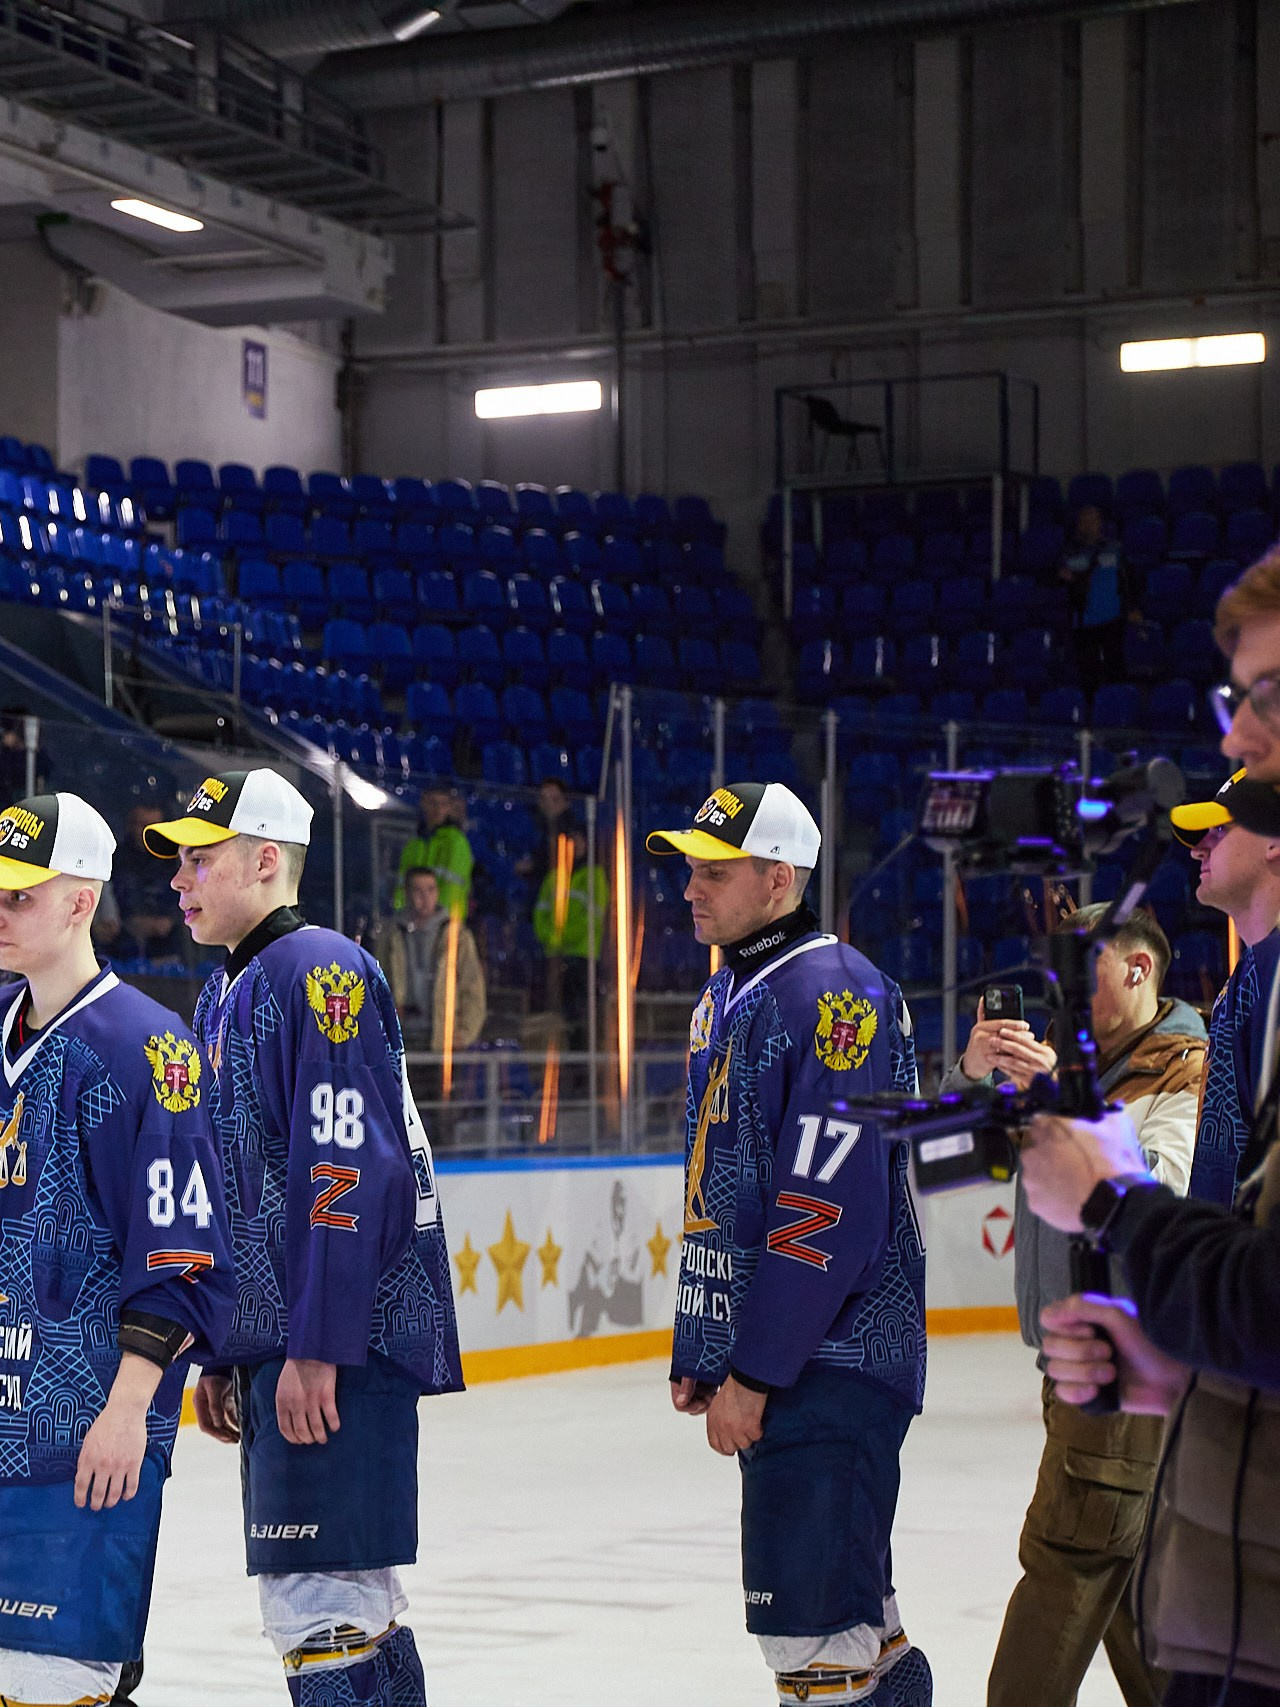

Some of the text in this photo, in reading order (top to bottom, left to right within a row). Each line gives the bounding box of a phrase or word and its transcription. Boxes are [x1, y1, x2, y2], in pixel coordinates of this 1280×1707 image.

[197, 796, 214, 812] 25
[709, 810, 727, 827] 25
[10, 832, 30, 850] 25
[739, 931, 787, 958] Reebok
[310, 1082, 365, 1150] 98
[791, 1113, 862, 1184] 17
[147, 1157, 214, 1229] 84
